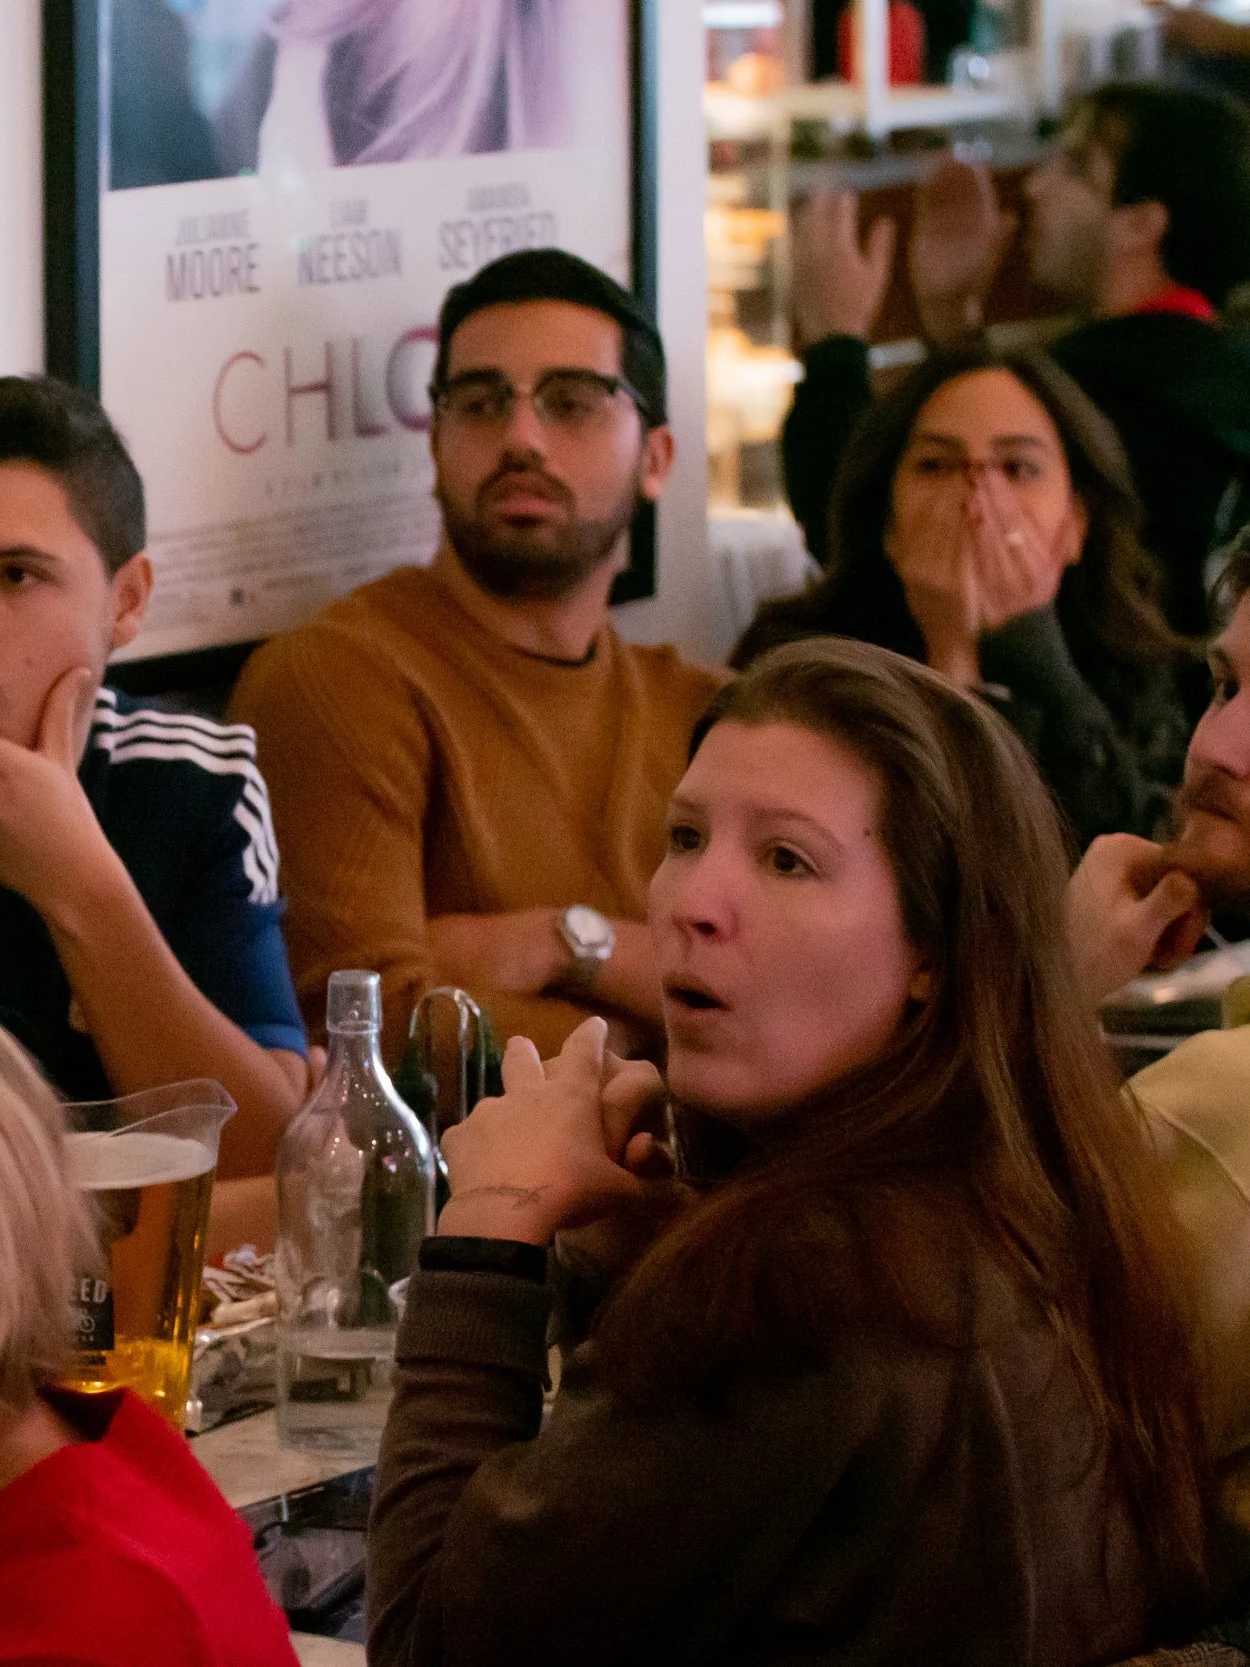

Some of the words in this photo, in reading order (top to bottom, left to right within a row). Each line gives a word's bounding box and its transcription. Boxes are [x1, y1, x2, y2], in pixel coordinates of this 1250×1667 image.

[165, 243, 260, 302] MOORE
[297, 228, 403, 286] NEESON
[212, 325, 442, 455] CHLO
[80, 1278, 106, 1304] ED
